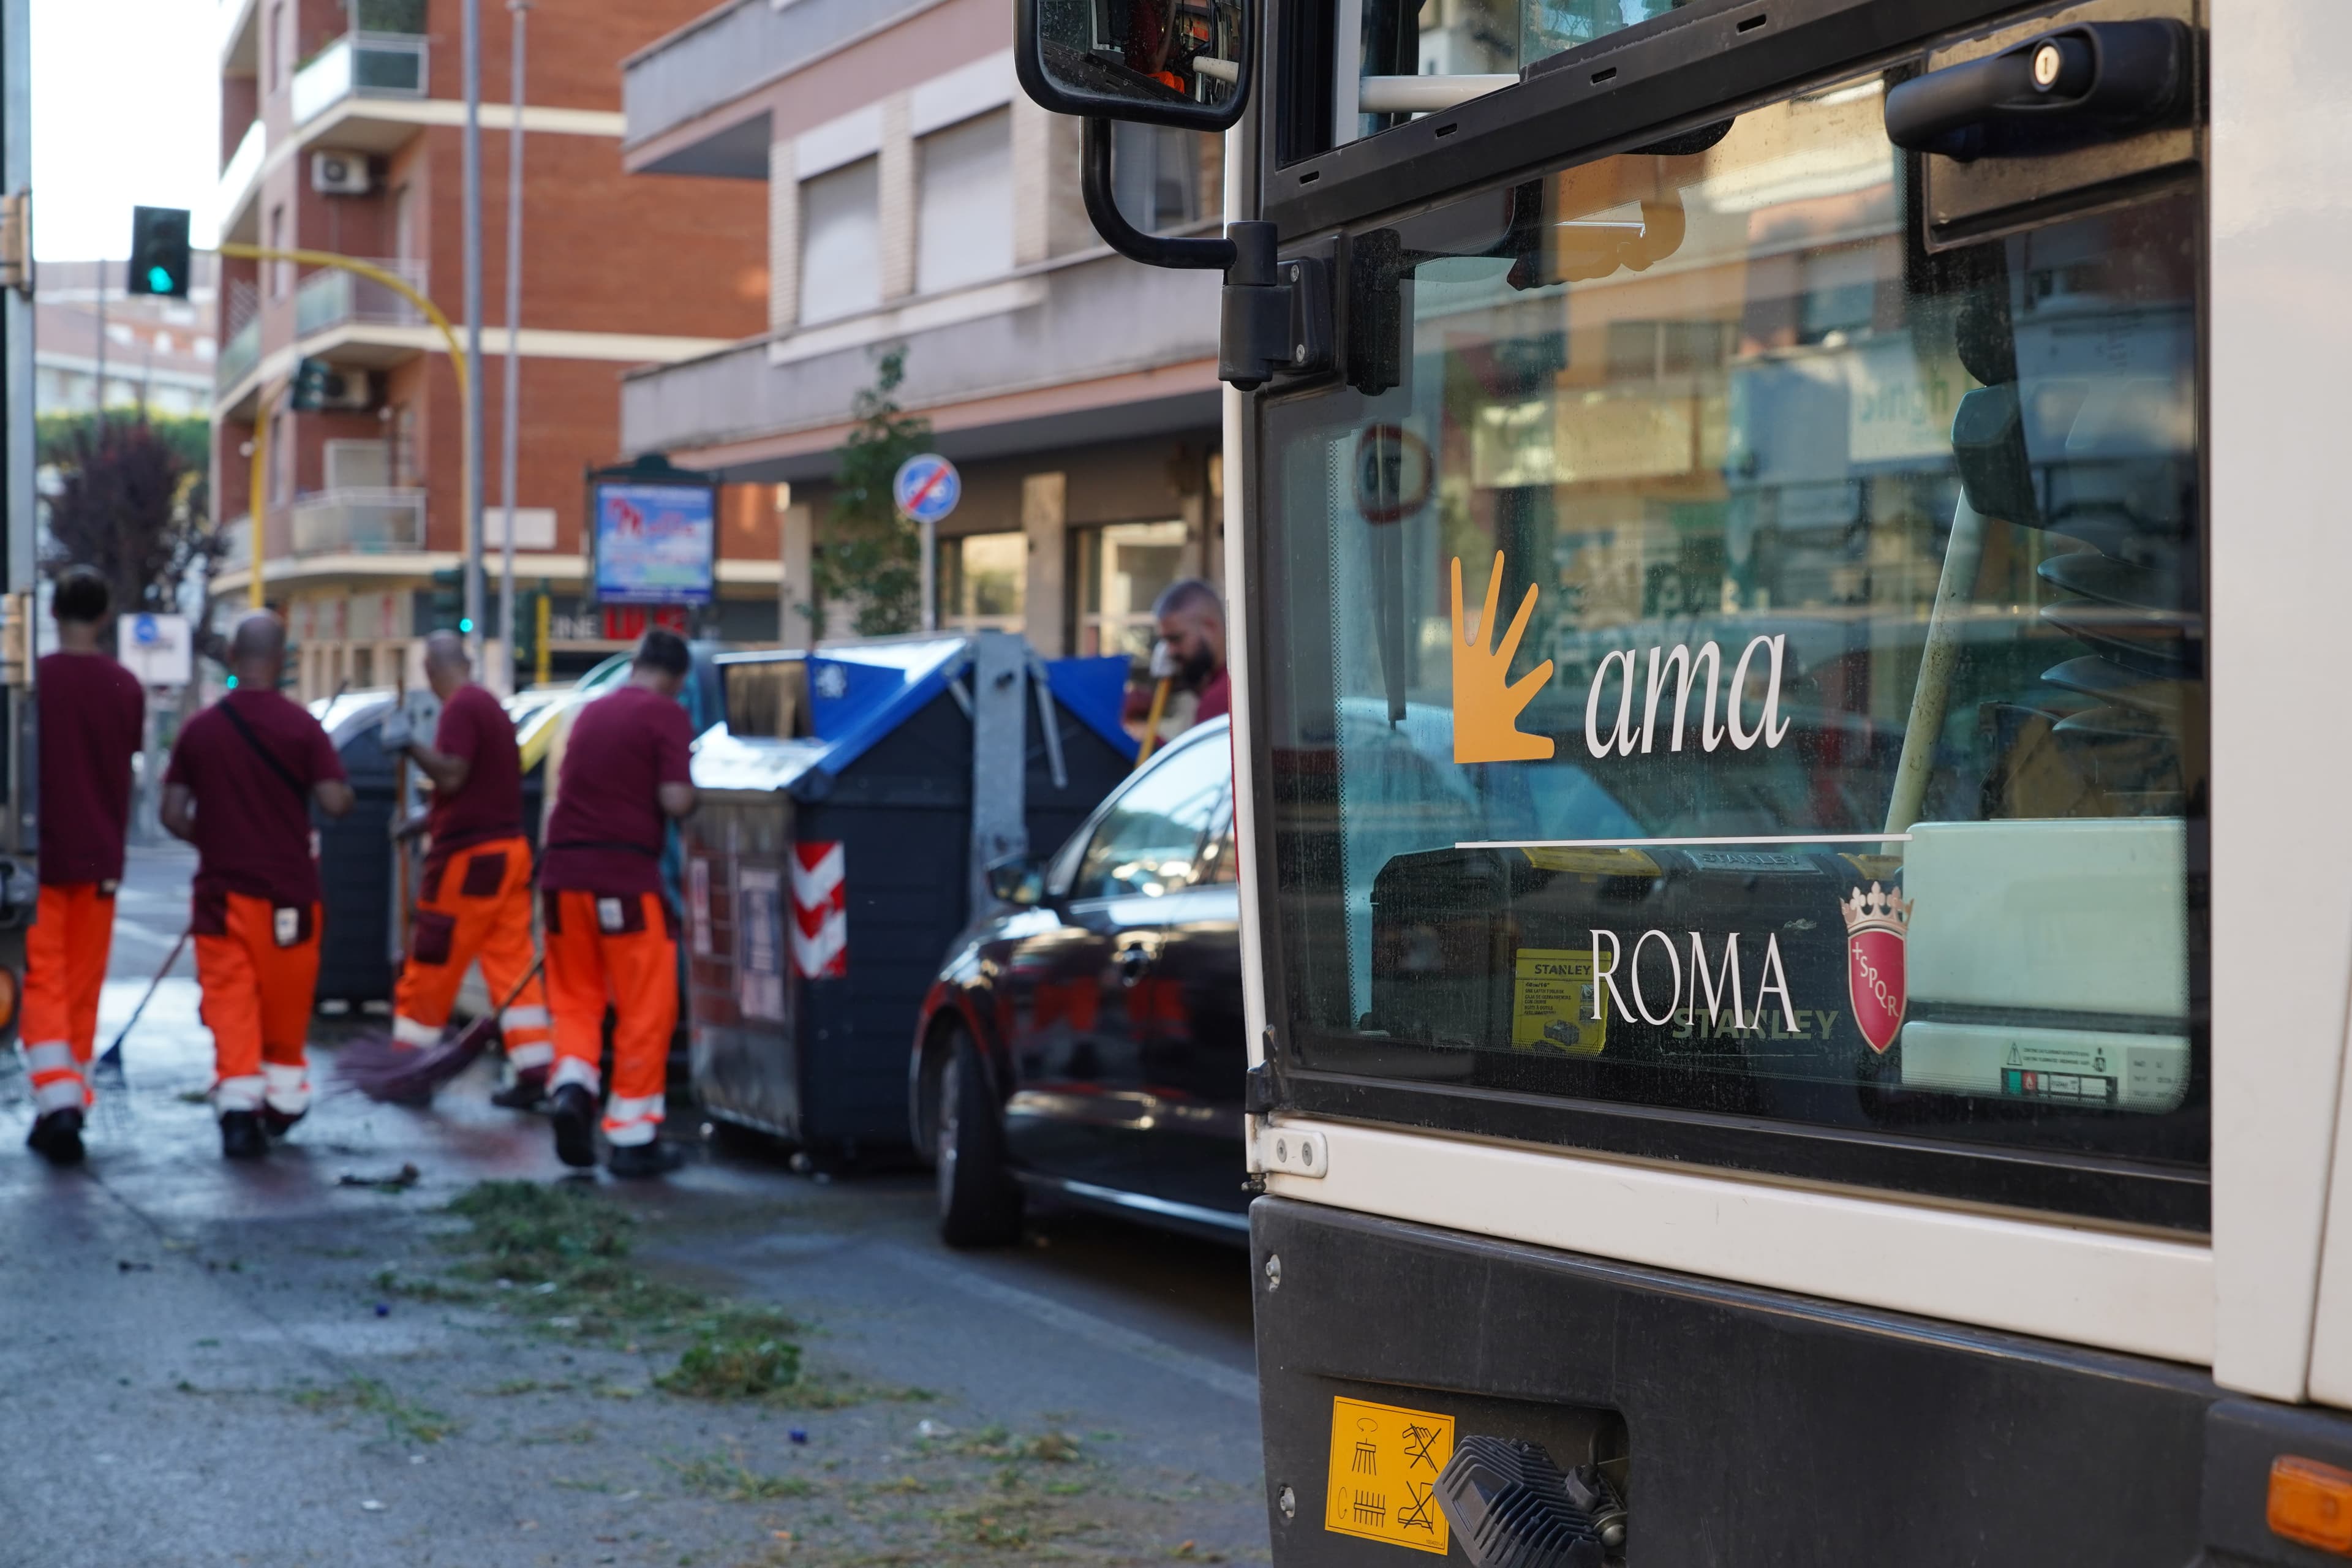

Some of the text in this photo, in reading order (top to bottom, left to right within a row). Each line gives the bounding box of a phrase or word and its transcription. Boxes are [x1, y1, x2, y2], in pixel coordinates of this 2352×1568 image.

[1585, 634, 1790, 758] ama
[1699, 854, 1800, 864] STANLEY
[1534, 964, 1591, 975] STANLEY
[1589, 930, 1801, 1032] ROMA
[1860, 956, 1899, 1017] SPQR
[1672, 1008, 1838, 1040] STANLEY
